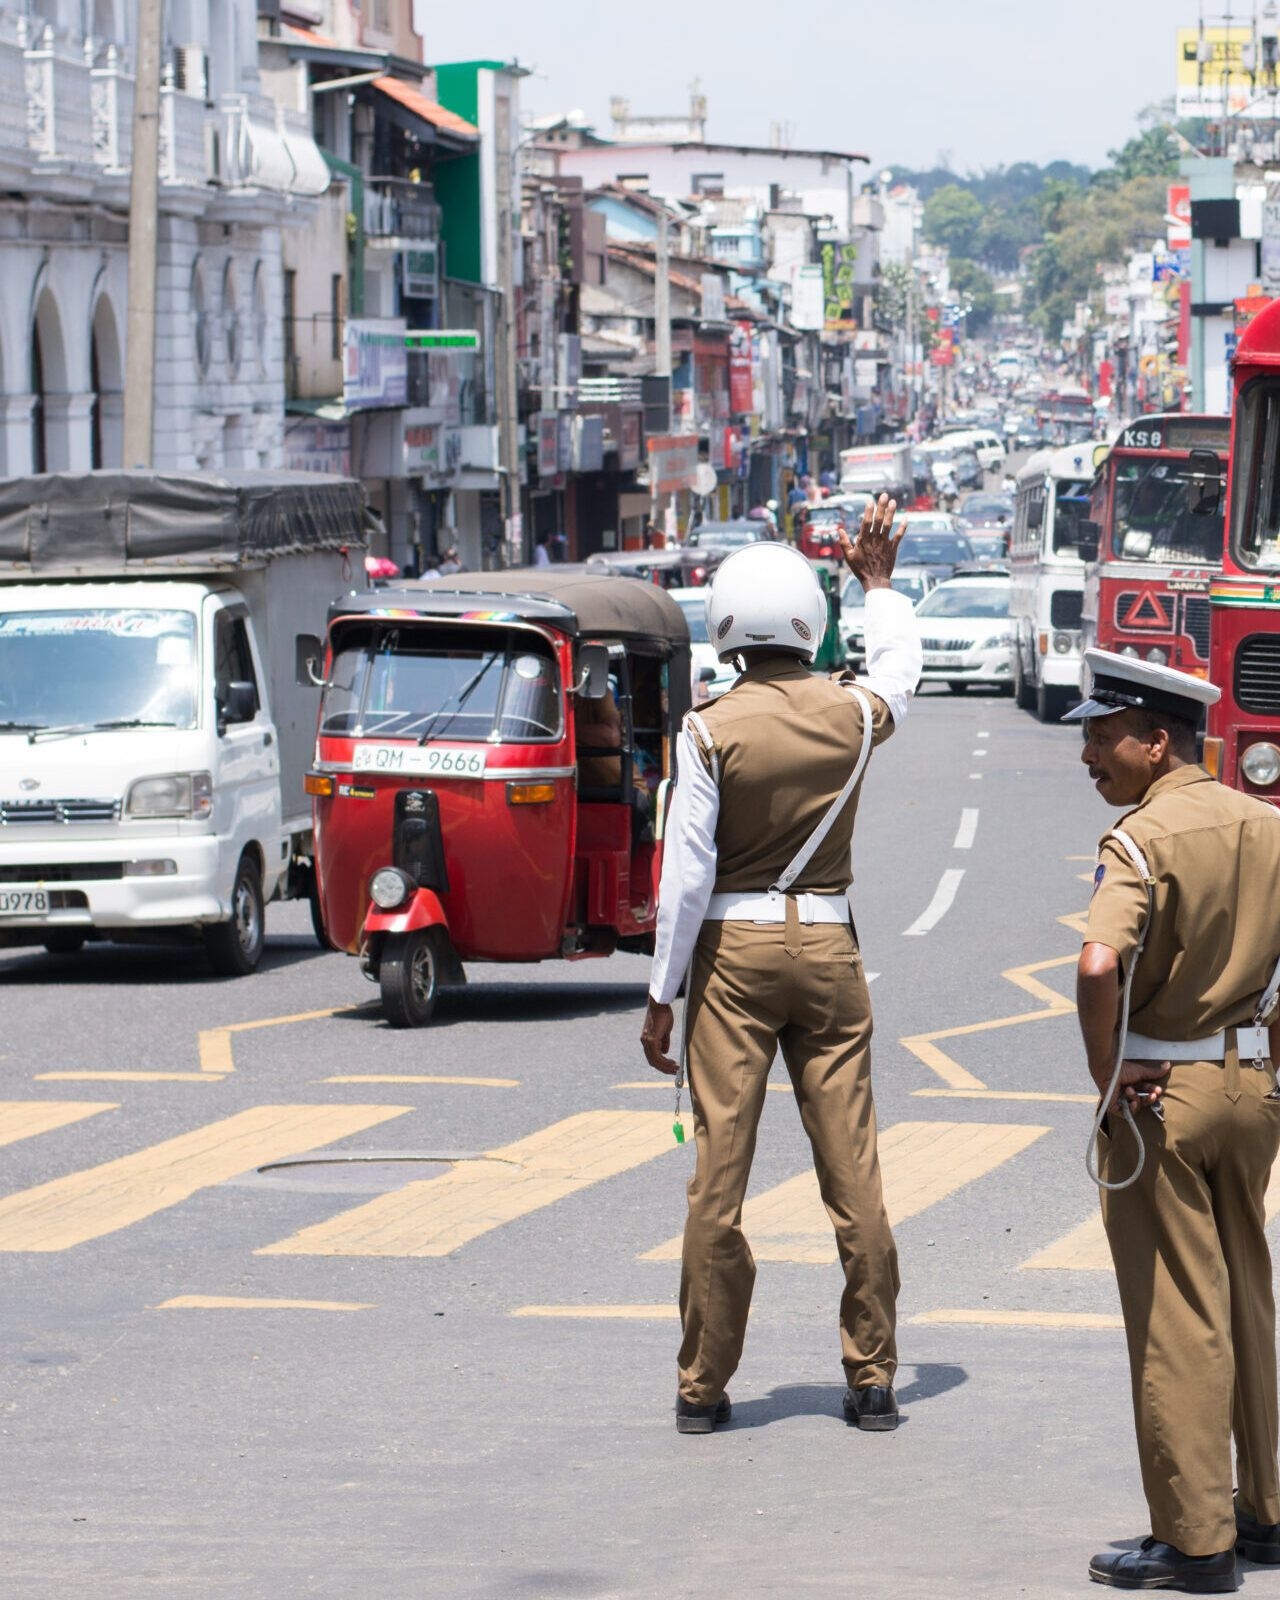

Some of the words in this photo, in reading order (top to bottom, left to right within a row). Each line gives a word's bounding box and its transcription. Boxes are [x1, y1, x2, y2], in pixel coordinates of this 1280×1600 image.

[1166, 582, 1205, 591] LANKA
[376, 749, 403, 768] QM
[429, 752, 480, 772] 9666
